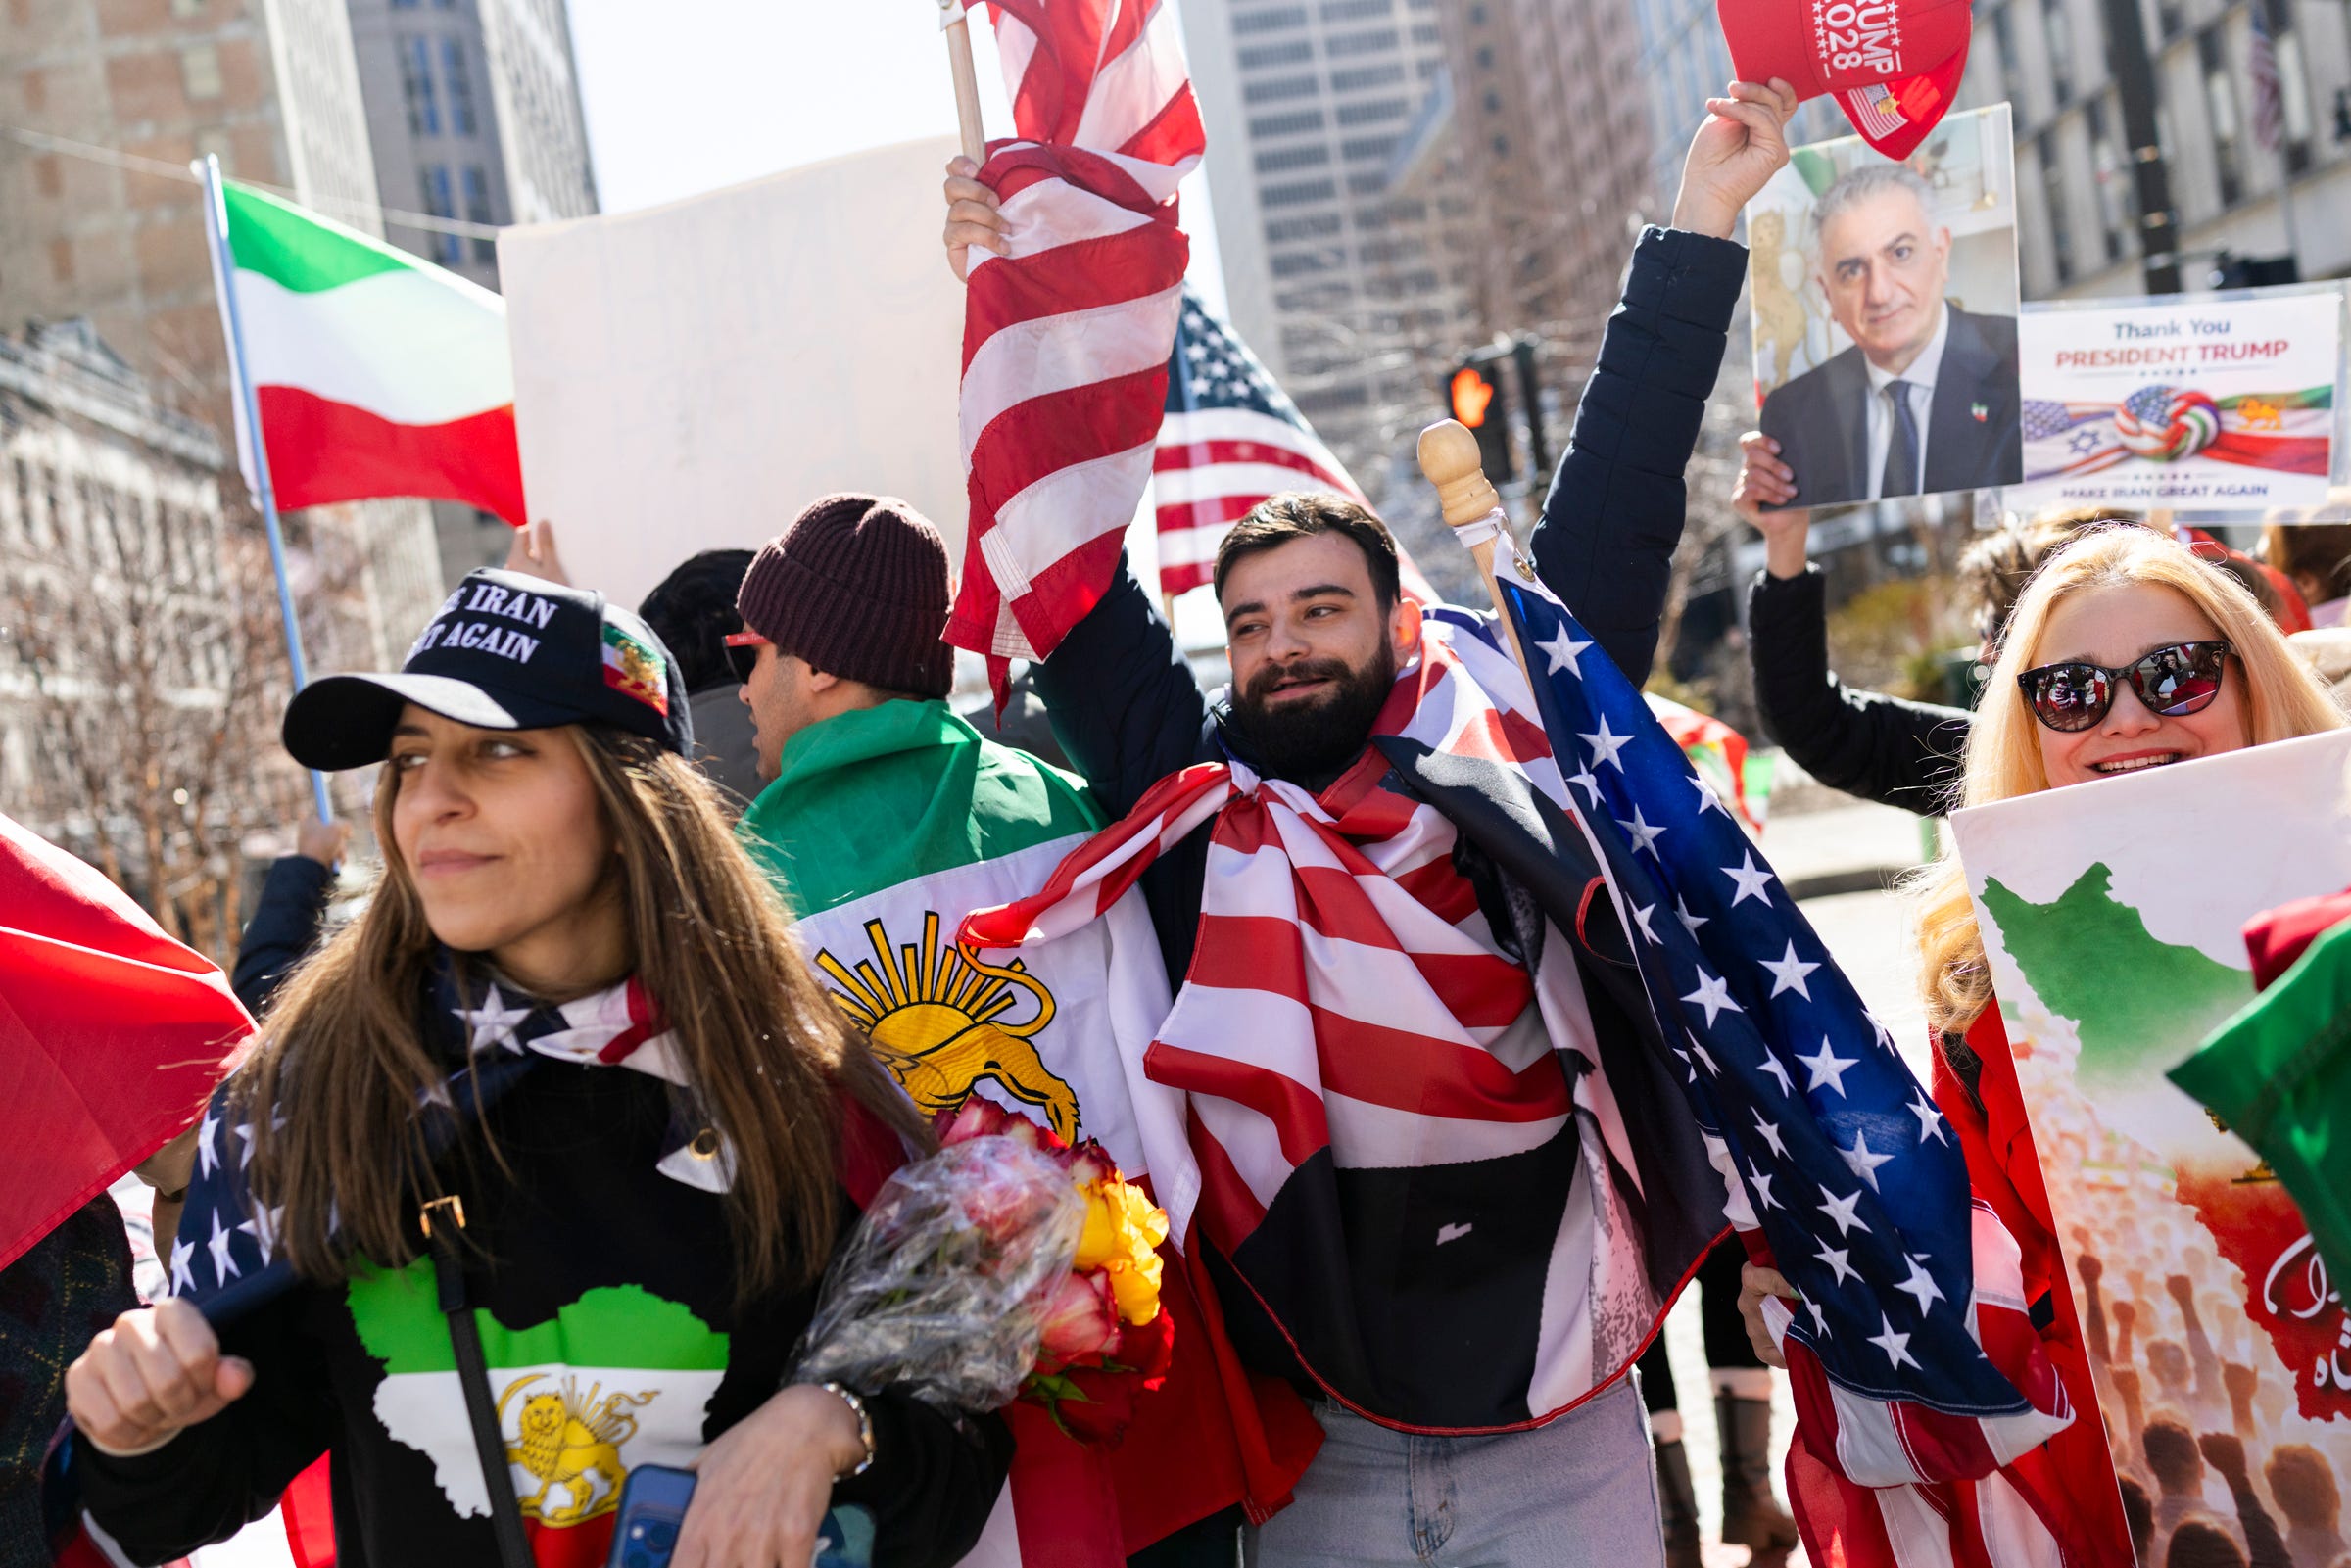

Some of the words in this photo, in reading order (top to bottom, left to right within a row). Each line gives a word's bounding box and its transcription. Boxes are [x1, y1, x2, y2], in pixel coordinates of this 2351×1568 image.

[1825, 0, 1863, 71] 028
[2113, 320, 2182, 340] Thank
[2188, 318, 2231, 336] You
[2055, 345, 2191, 368] PRESIDENT
[2198, 339, 2289, 362] TRUMP
[2060, 487, 2107, 499] MAKE
[2112, 486, 2152, 499] IRAN
[2156, 485, 2209, 498] GREAT
[2213, 484, 2269, 498] AGAIN
[464, 584, 559, 630] IRAN
[440, 620, 541, 664] AGAIN
